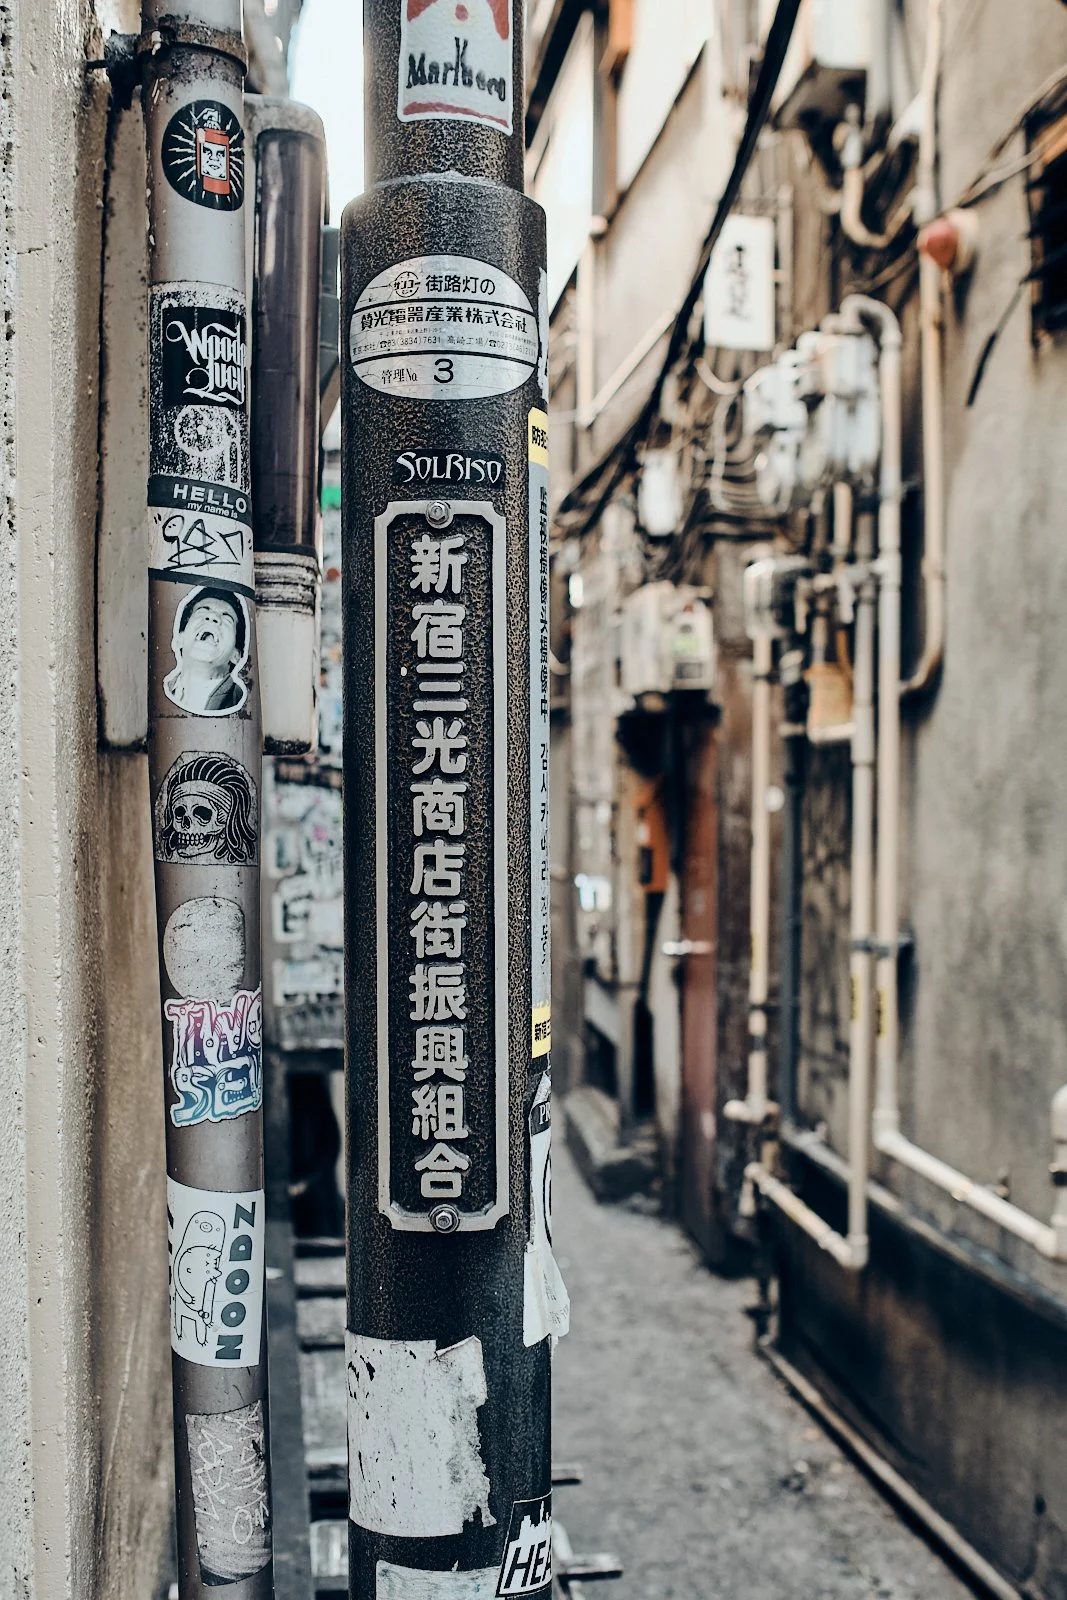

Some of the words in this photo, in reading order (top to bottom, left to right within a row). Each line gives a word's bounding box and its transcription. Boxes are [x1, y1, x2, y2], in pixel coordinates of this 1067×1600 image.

[425, 274, 496, 296] 街路灯の
[433, 358, 454, 384] 3
[173, 483, 247, 514] HELLO
[187, 502, 203, 512] my
[204, 505, 230, 517] name
[230, 509, 239, 519] is
[409, 533, 469, 1198] 新宿三光商店街振興組合
[215, 1201, 257, 1360] NOODZ
